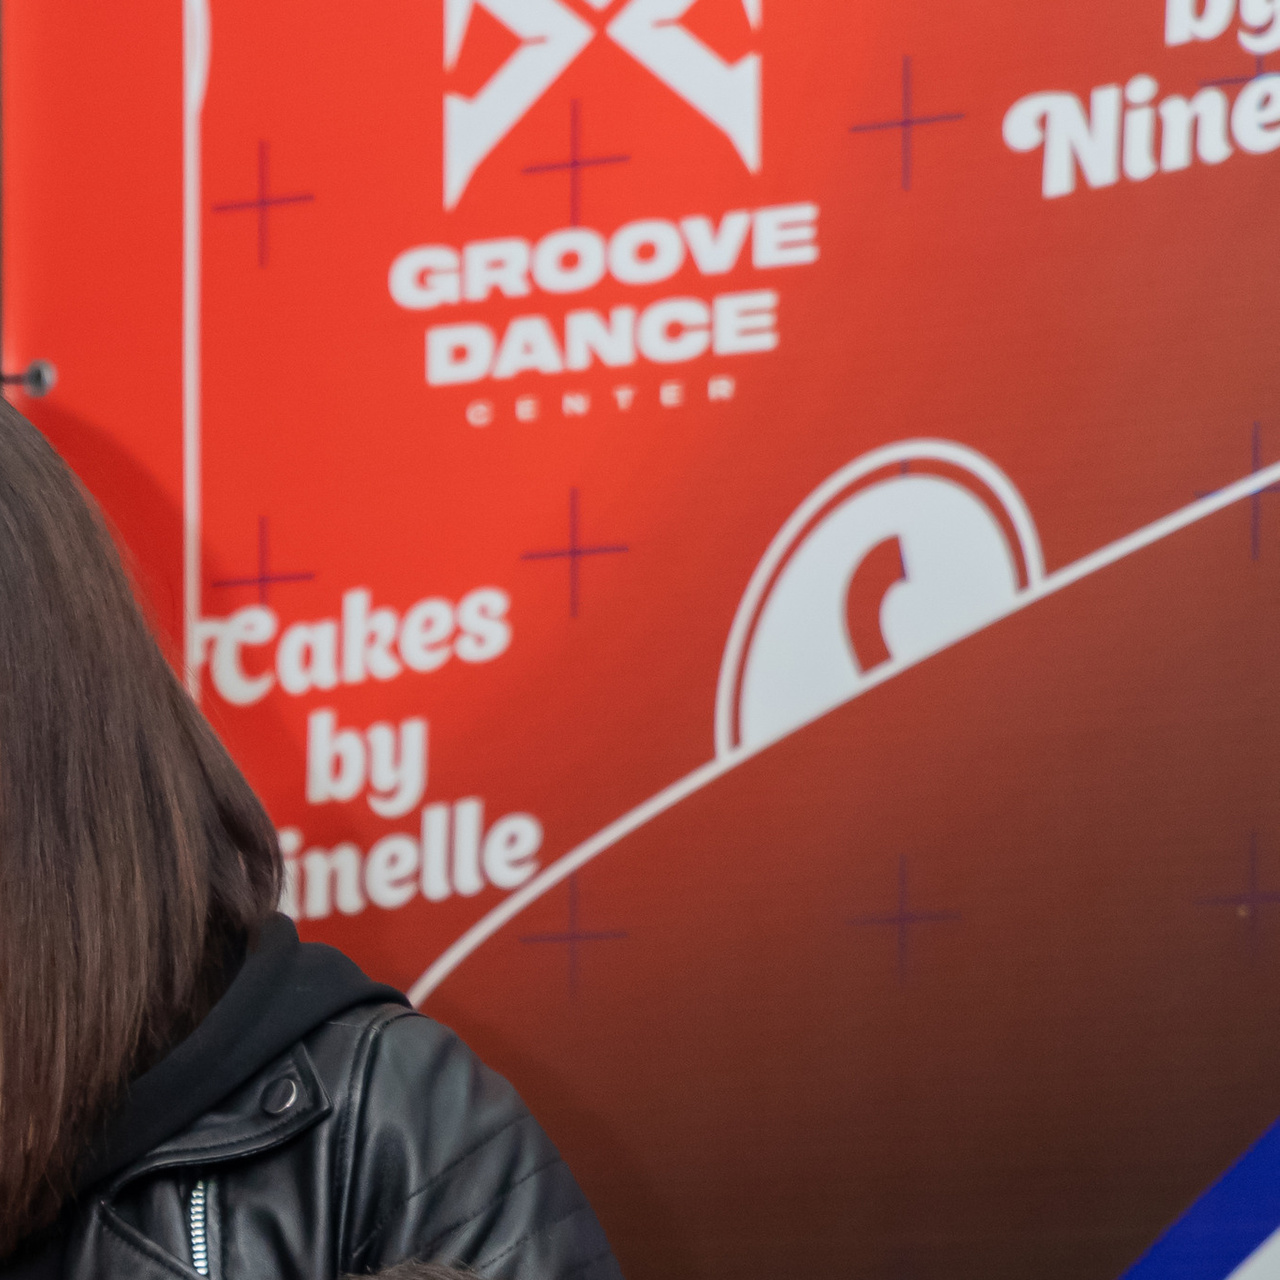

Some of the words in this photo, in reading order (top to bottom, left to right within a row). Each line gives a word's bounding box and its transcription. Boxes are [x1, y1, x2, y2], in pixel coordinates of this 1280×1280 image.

[388, 202, 819, 311] GROOVE
[425, 289, 779, 386] DANCE
[466, 375, 736, 427] CENTER
[186, 584, 513, 706] Cakes
[306, 707, 428, 819] by
[276, 797, 544, 922] inelle
